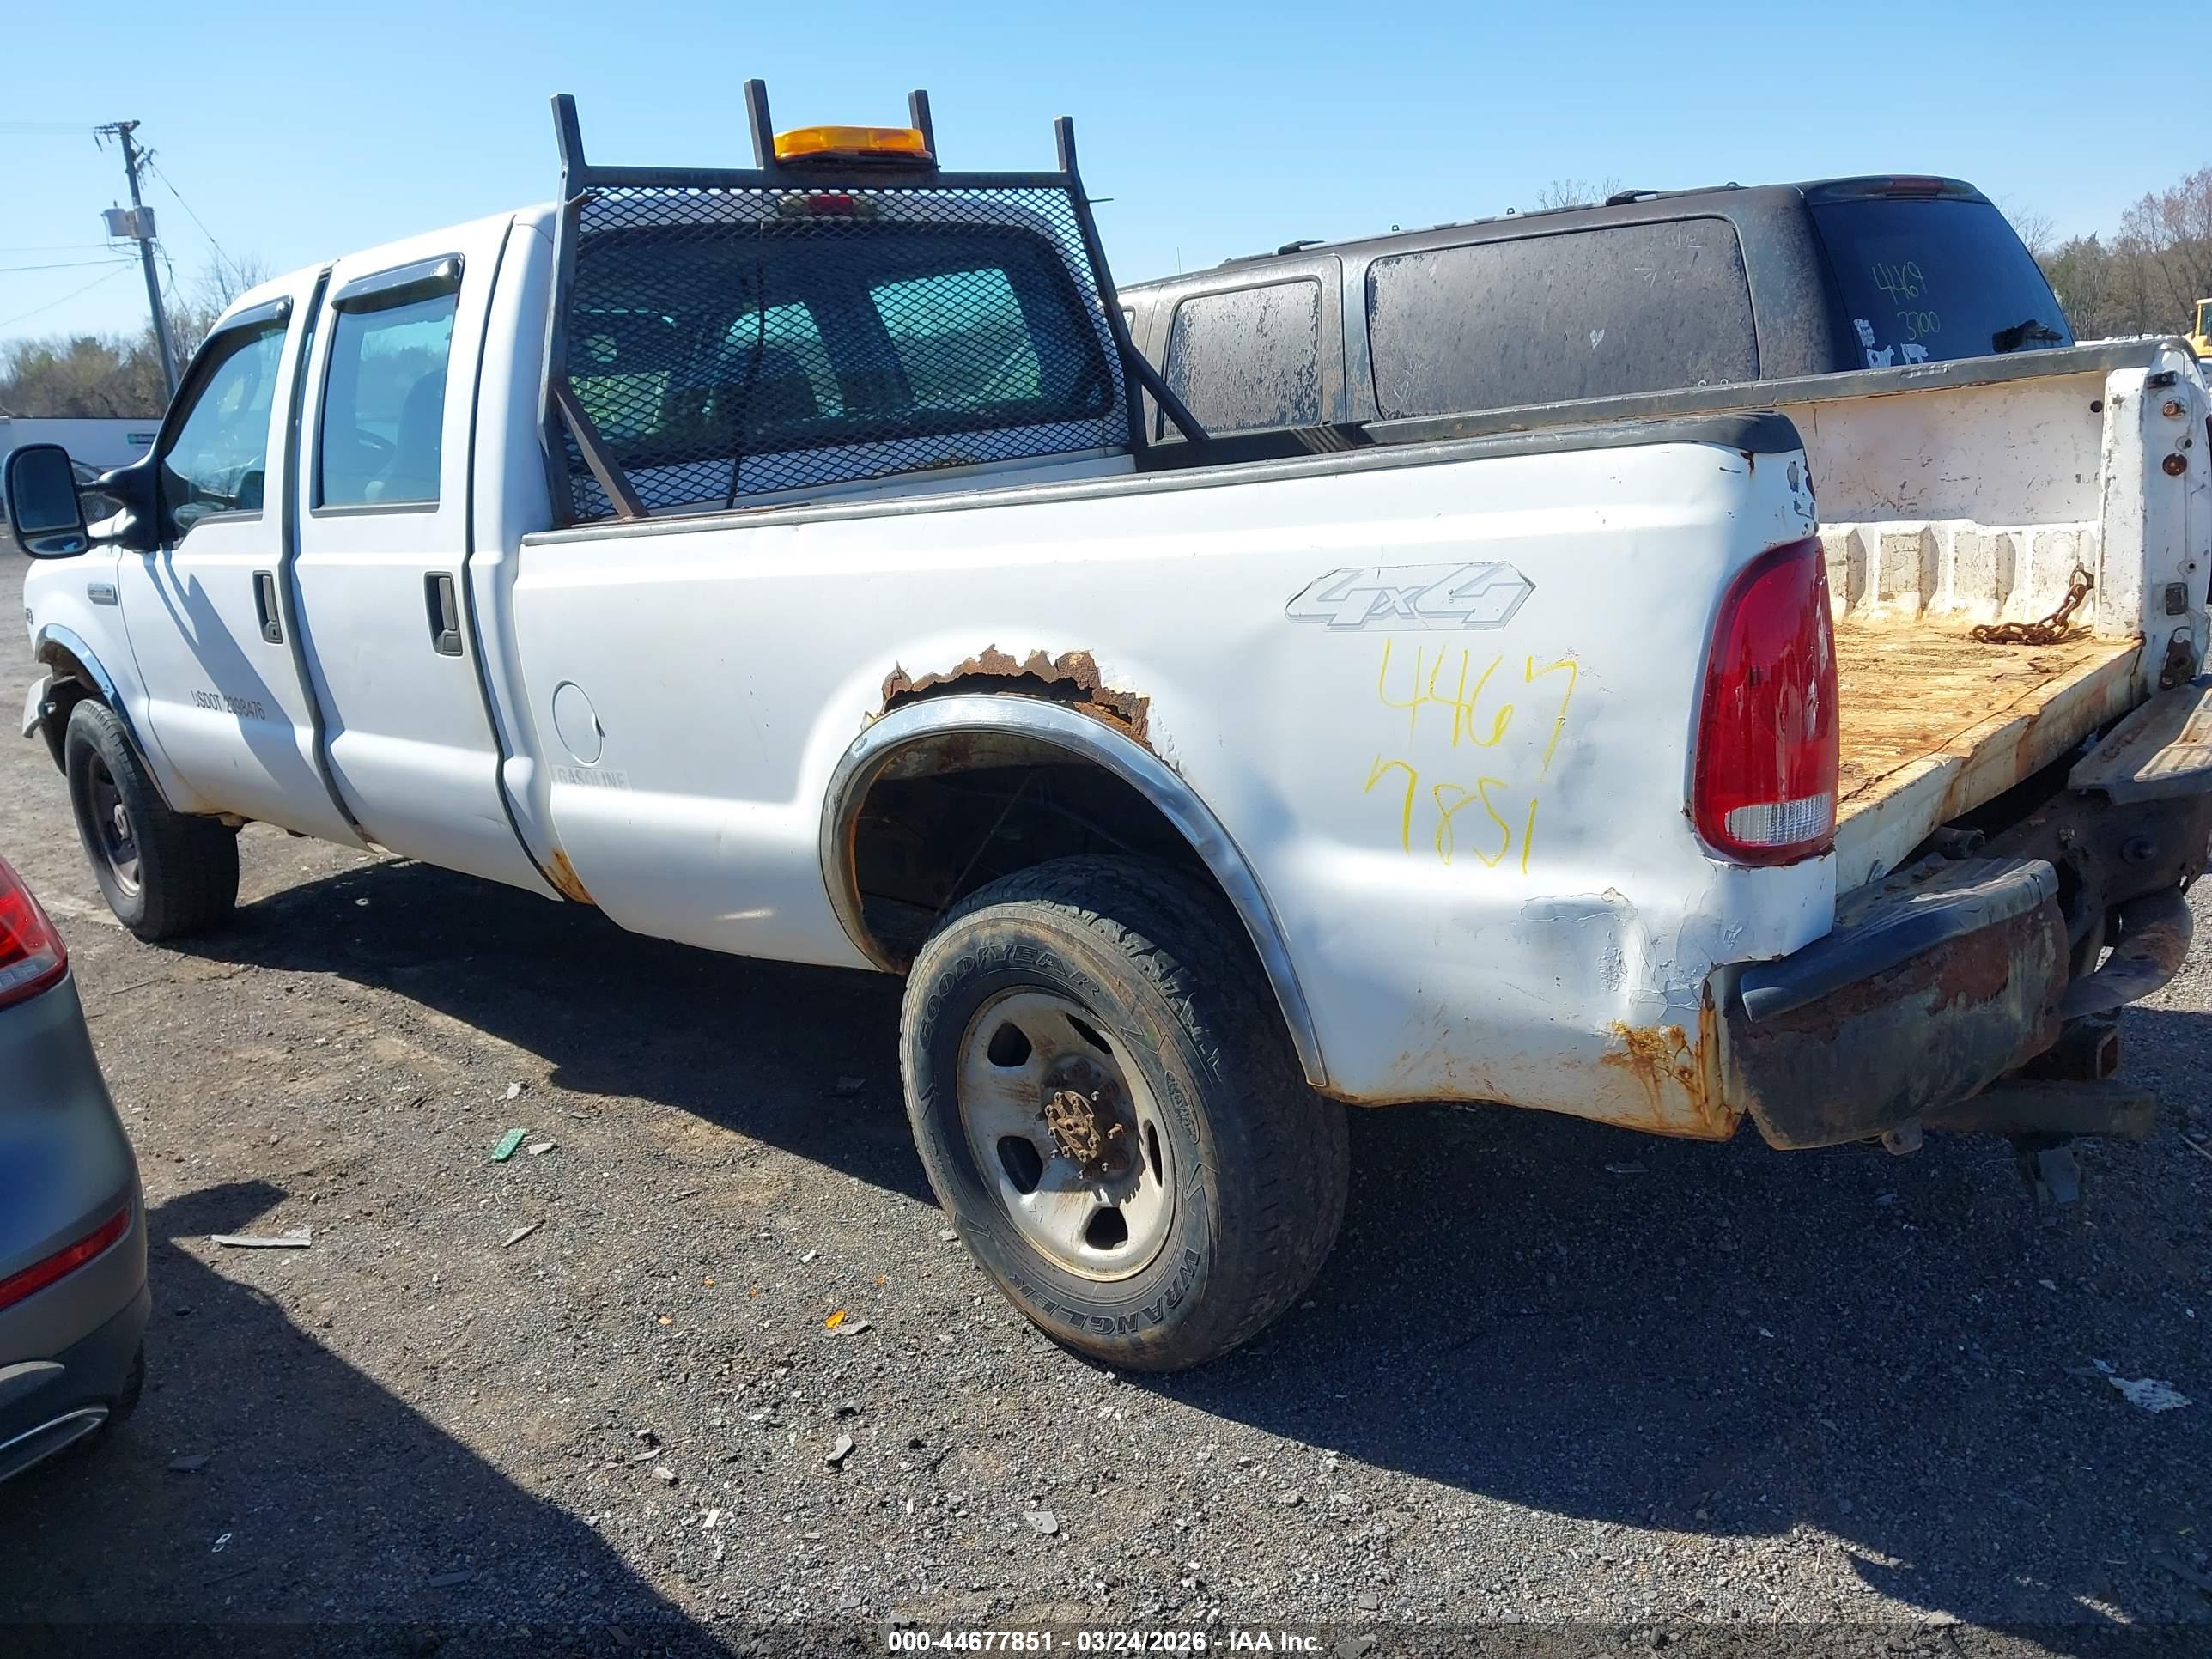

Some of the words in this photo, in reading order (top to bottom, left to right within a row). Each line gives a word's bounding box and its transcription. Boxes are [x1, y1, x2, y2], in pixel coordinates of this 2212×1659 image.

[1872, 260, 1928, 305] 4469
[1285, 563, 1535, 631] 4x4
[191, 690, 222, 712] USDOT
[1378, 636, 1578, 783] 4467
[557, 767, 626, 789] GASOLINE
[1364, 753, 1540, 877] 7851
[919, 945, 1102, 1051] GOODYEAR
[1008, 1246, 1201, 1335] WRANGLER
